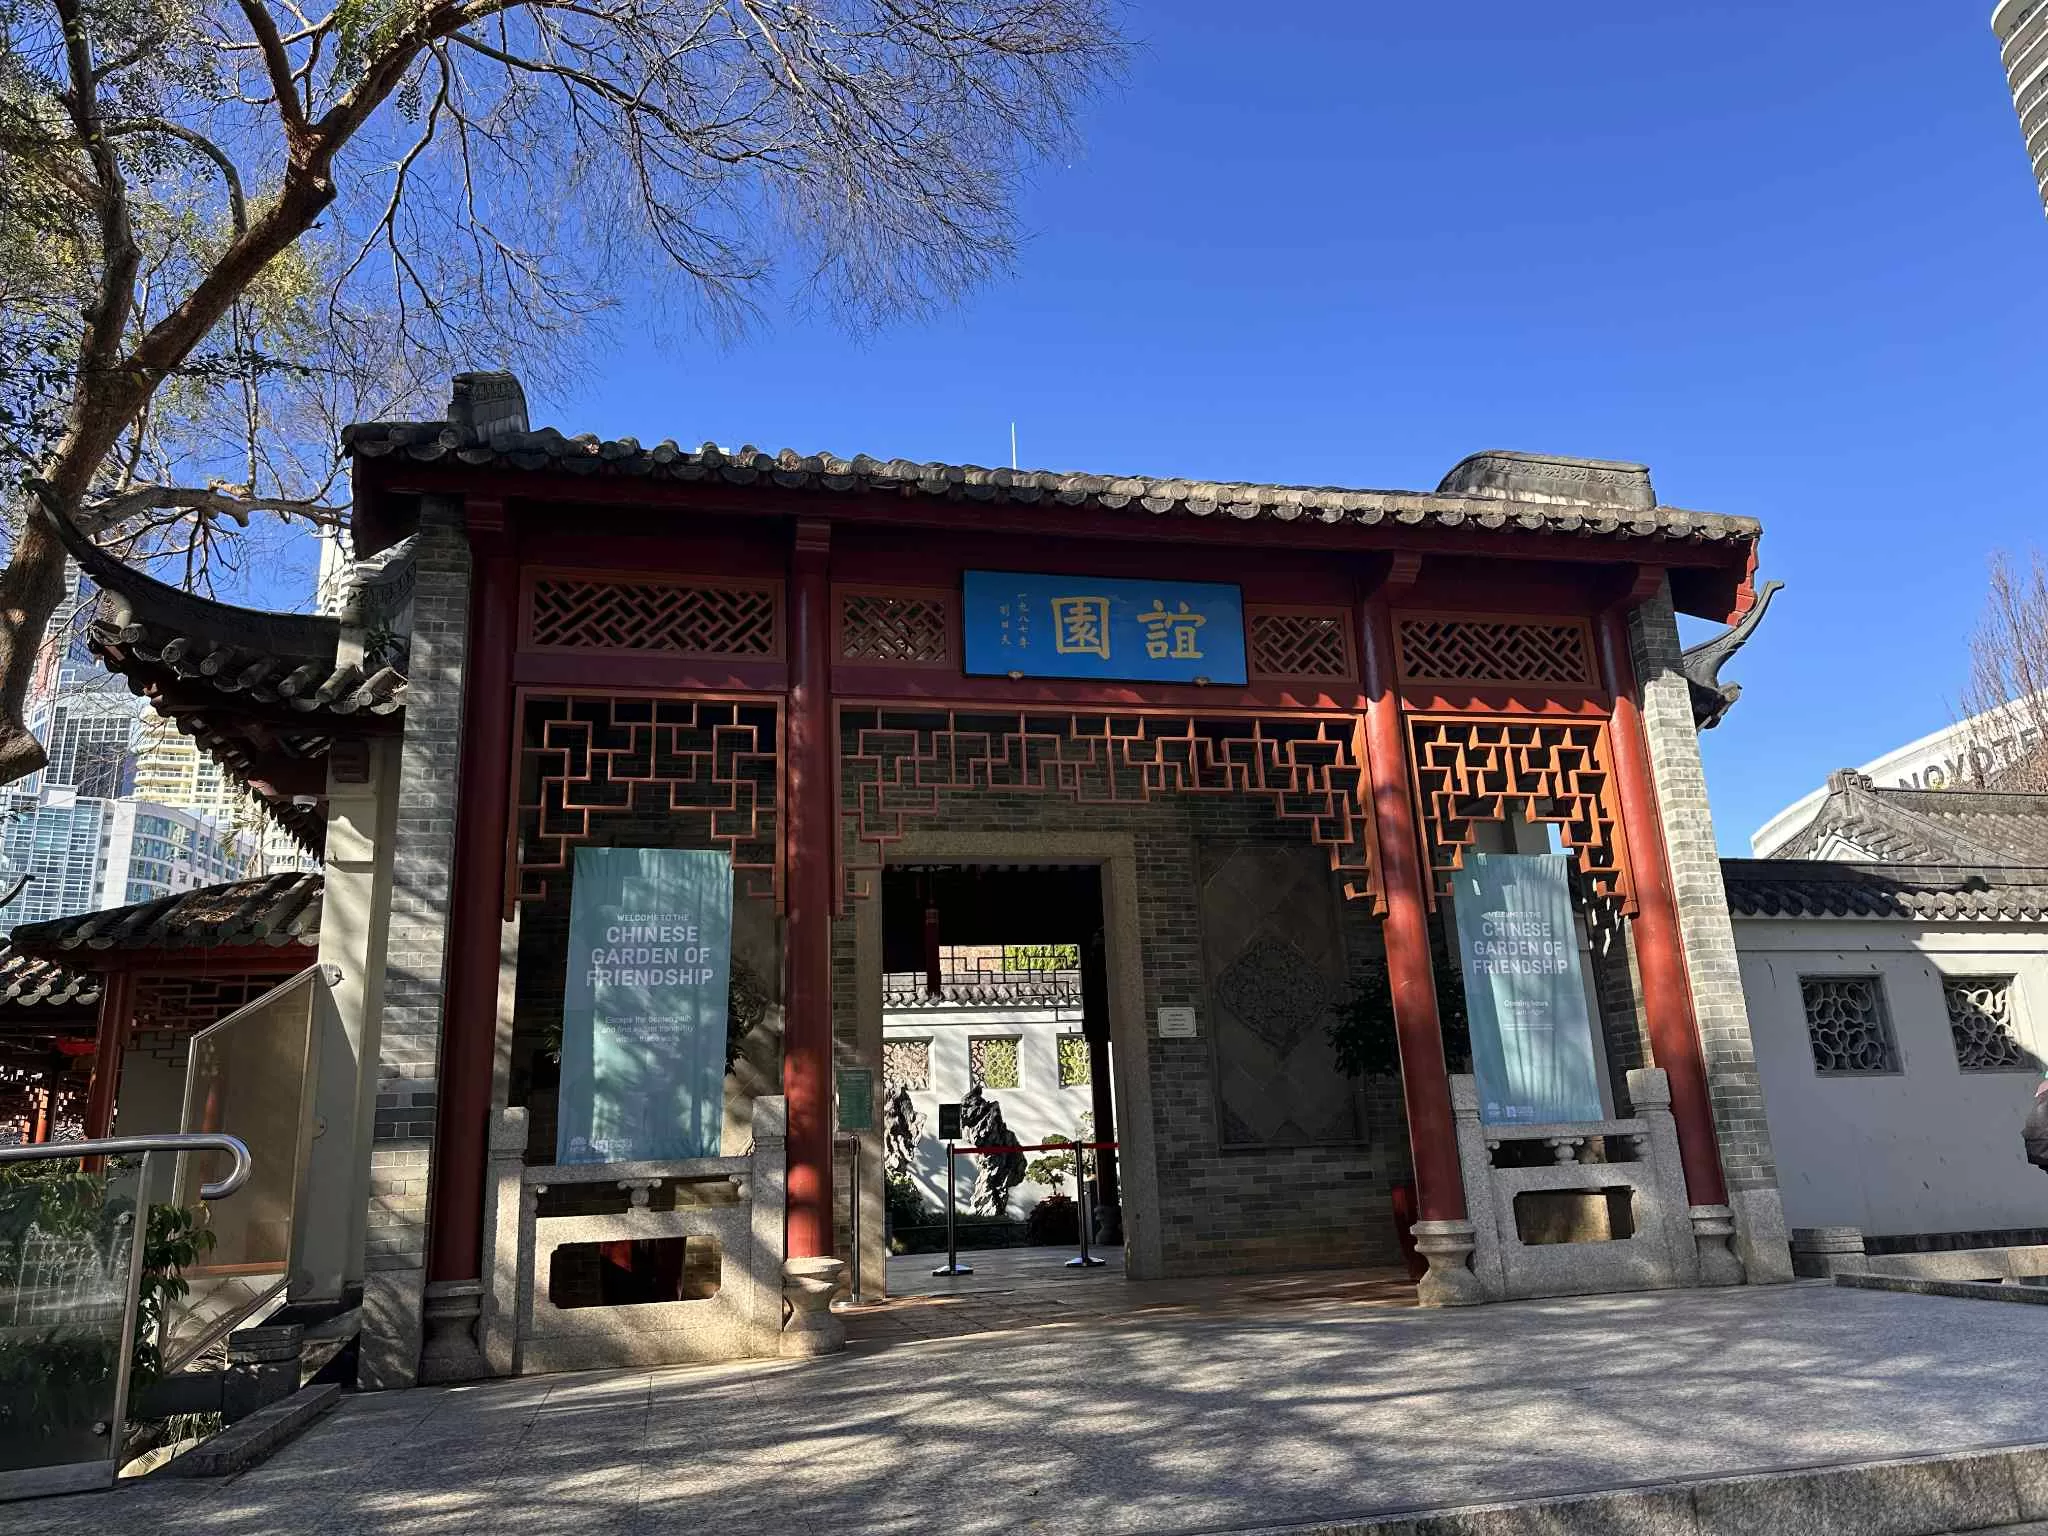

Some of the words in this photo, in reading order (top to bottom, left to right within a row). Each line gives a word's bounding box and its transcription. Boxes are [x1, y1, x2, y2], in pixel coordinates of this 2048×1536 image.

[616, 912, 657, 922] WELCOME
[606, 926, 699, 943] CHINESE
[1482, 922, 1551, 937] CHINESE
[591, 948, 678, 965] GARDEN
[684, 947, 712, 964] OF
[1474, 941, 1539, 956] GARDEN
[1543, 941, 1562, 956] OF
[1472, 960, 1568, 975] FRIENDSHIP
[586, 968, 714, 987] FRIENDSHIP
